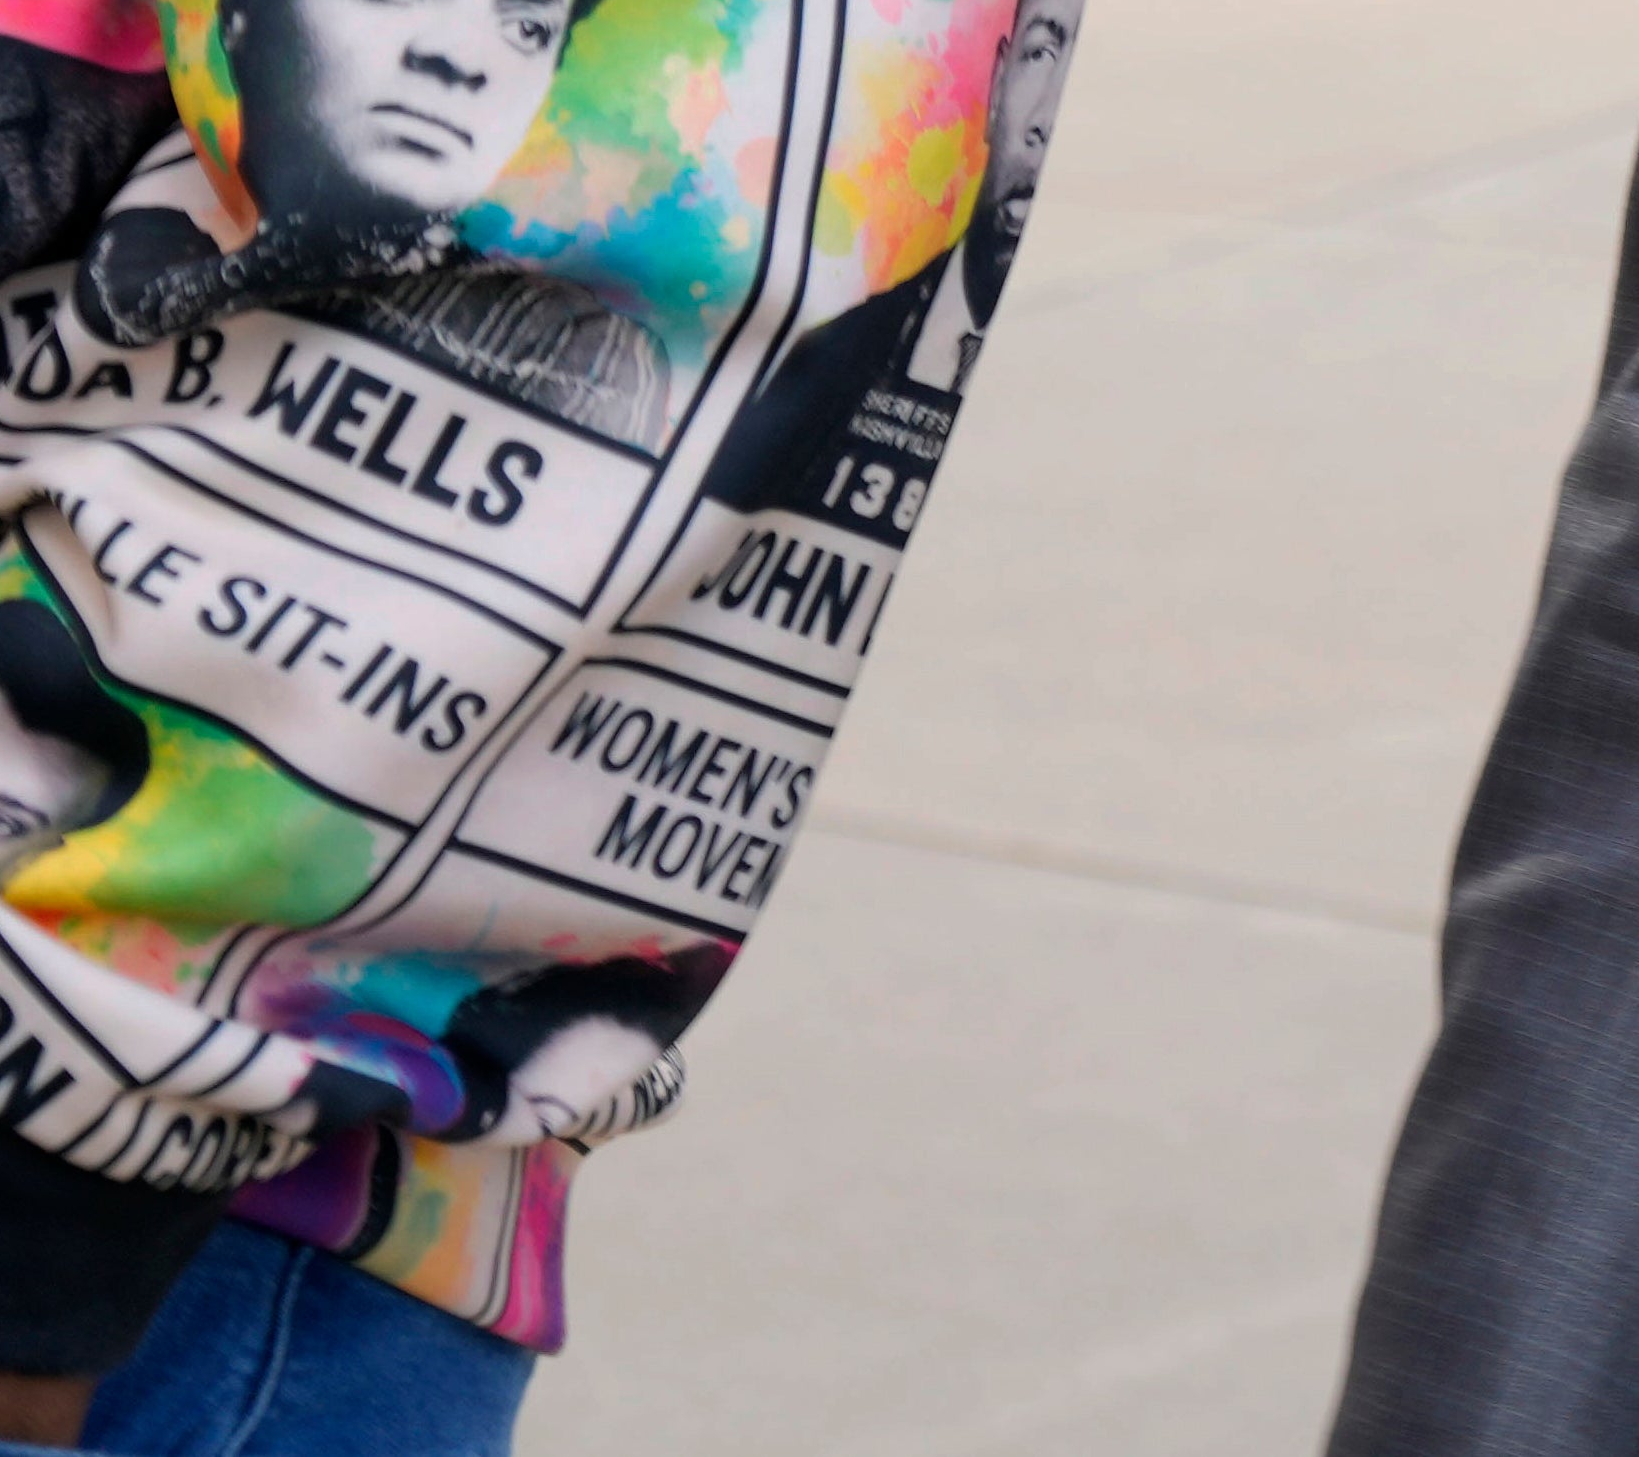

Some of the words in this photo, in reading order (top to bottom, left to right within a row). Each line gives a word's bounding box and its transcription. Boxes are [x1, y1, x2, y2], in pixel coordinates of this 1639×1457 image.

[243, 338, 547, 532] WELLS
[198, 574, 491, 756] SIT-INS
[697, 528, 873, 648] JOHN
[549, 690, 818, 833] WOMEN'S
